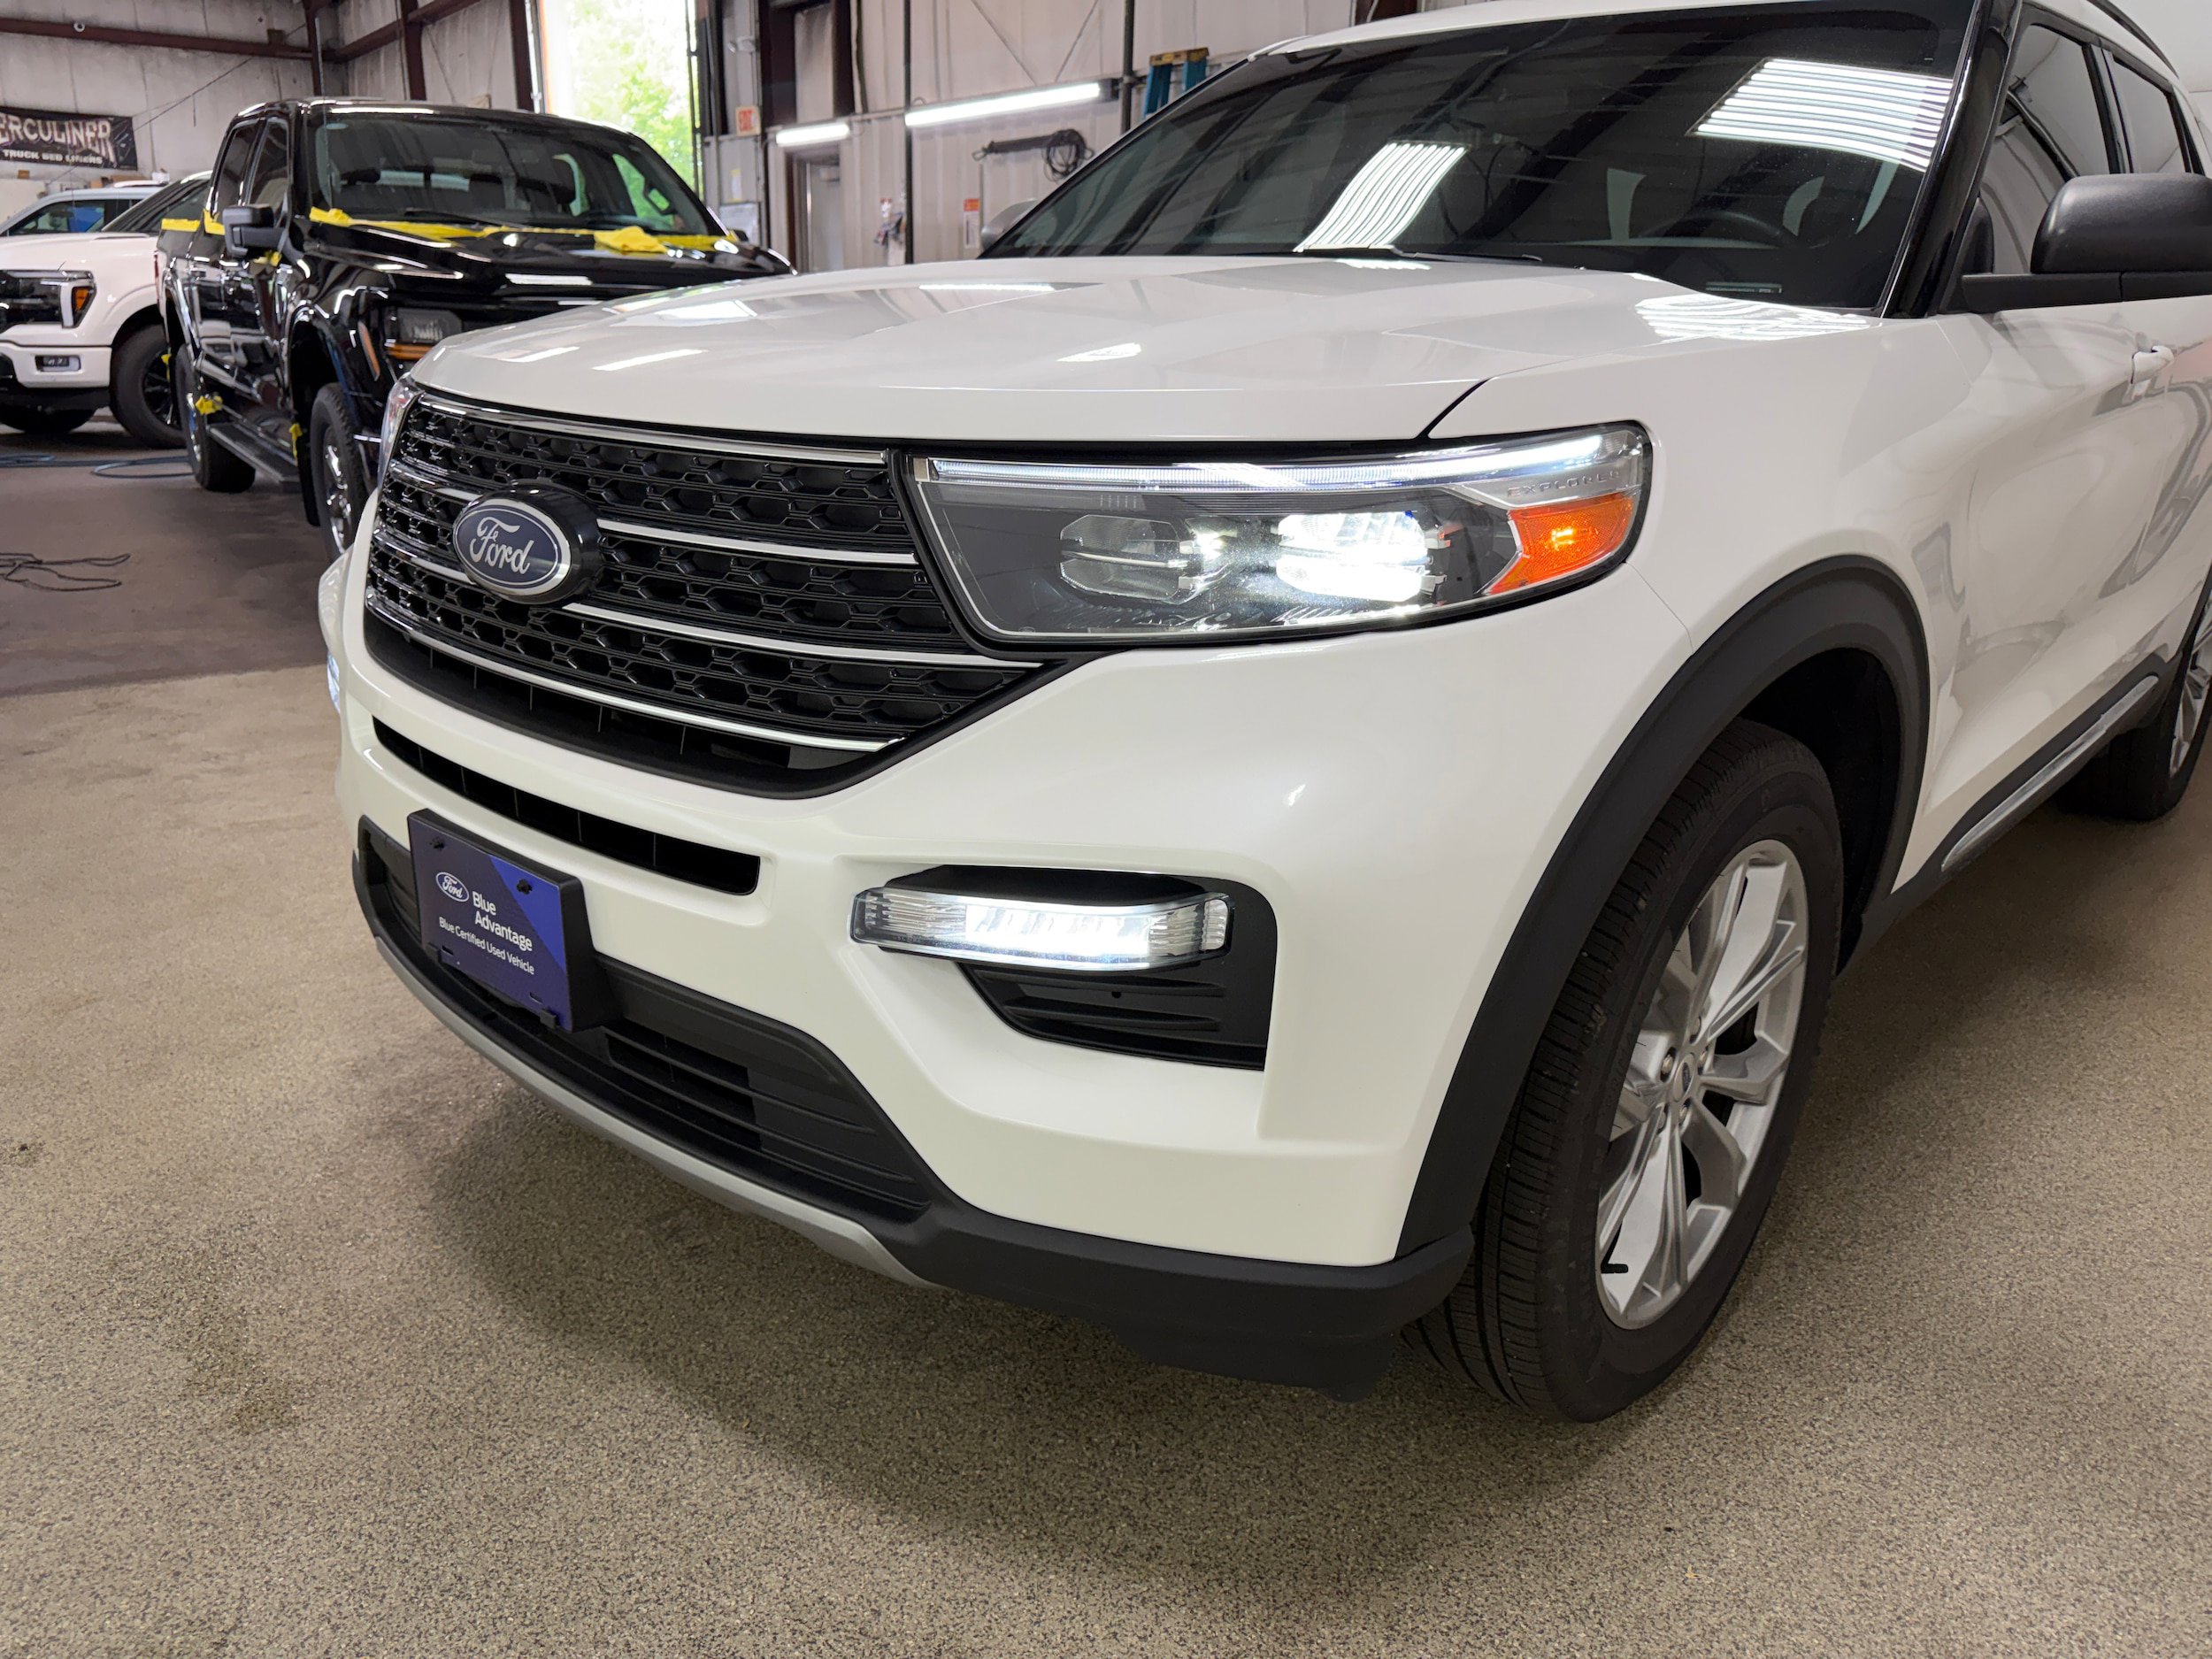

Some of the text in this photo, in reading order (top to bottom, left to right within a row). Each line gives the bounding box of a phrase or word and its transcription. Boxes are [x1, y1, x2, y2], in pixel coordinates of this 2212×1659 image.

[3, 149, 40, 160] TRUCK
[42, 152, 63, 162] BED
[1507, 470, 1619, 497] EXPLORER
[469, 516, 534, 575] Ford
[442, 875, 464, 899] Ford
[472, 891, 497, 916] Blue
[474, 910, 534, 952] Advantage
[439, 917, 535, 976] Blue Certified Used Vehicle
